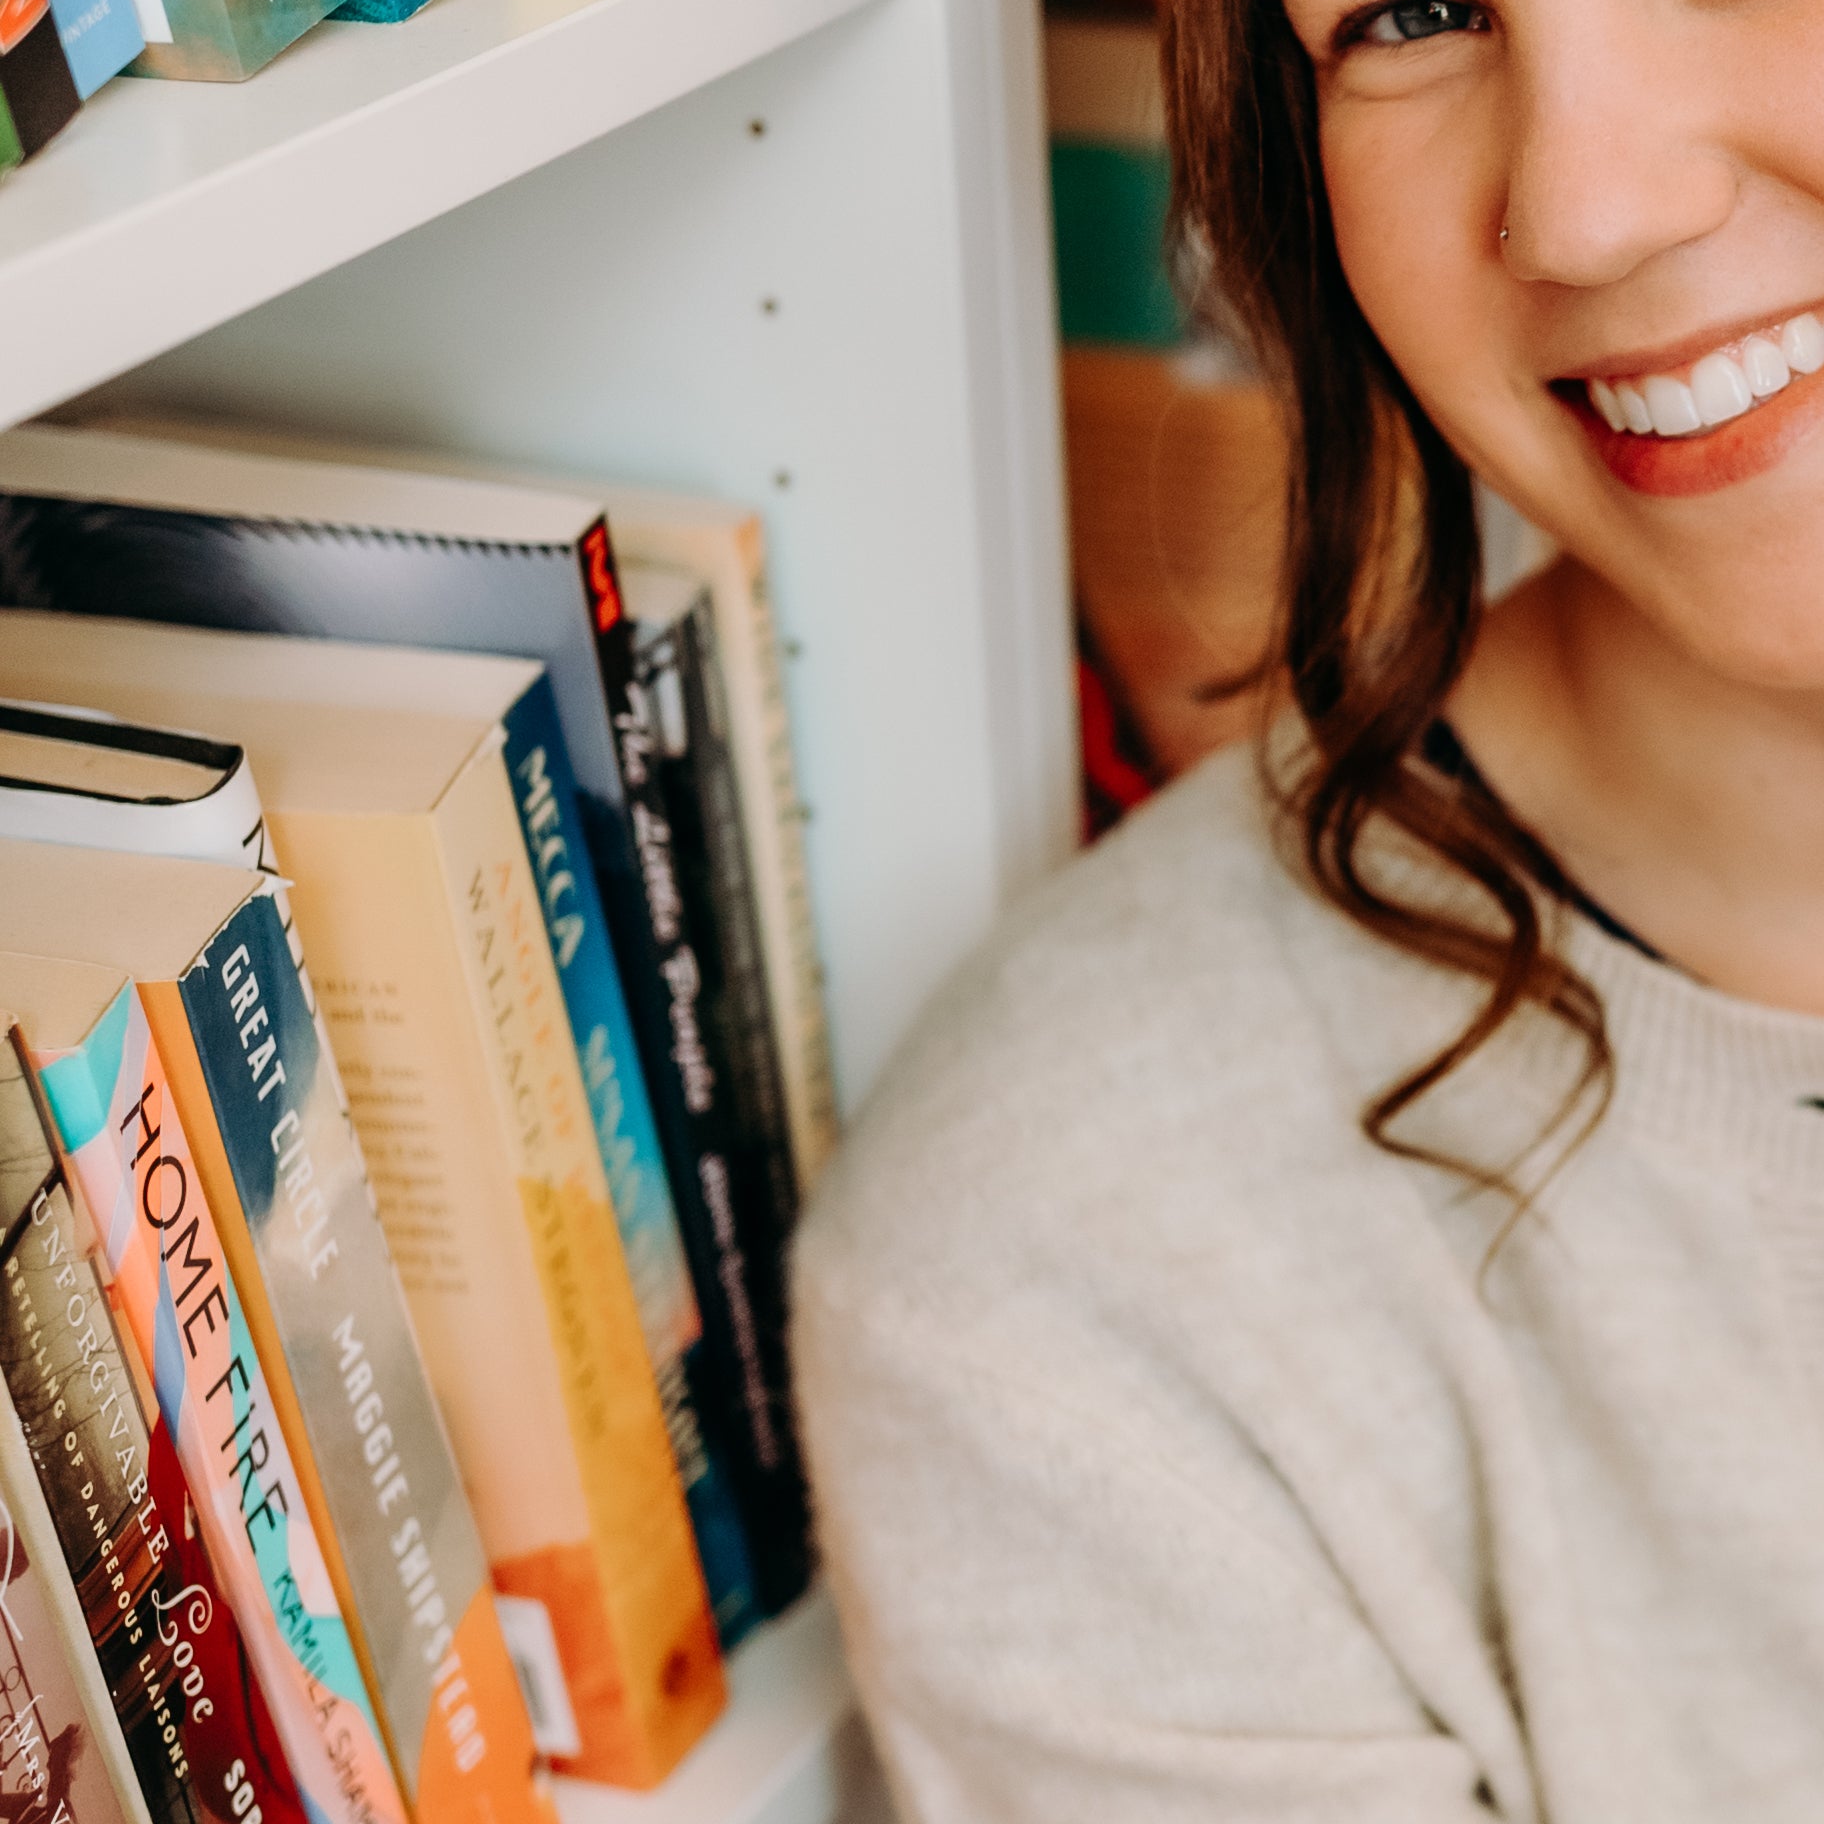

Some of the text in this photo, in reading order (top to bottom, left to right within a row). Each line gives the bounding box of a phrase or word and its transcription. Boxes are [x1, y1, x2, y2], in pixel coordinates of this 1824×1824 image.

[519, 745, 586, 969] MECCA
[221, 943, 340, 1282] GREAT CIRCLE
[31, 1185, 169, 1566] UNFORGIVABLE
[119, 1081, 291, 1557] HOME FIRE
[331, 1312, 410, 1518] MAGGIE
[5, 1255, 67, 1420] RETELLING
[64, 1431, 85, 1468] OF
[81, 1481, 143, 1646] DANGEROUS
[138, 1653, 189, 1780] LIAISONS
